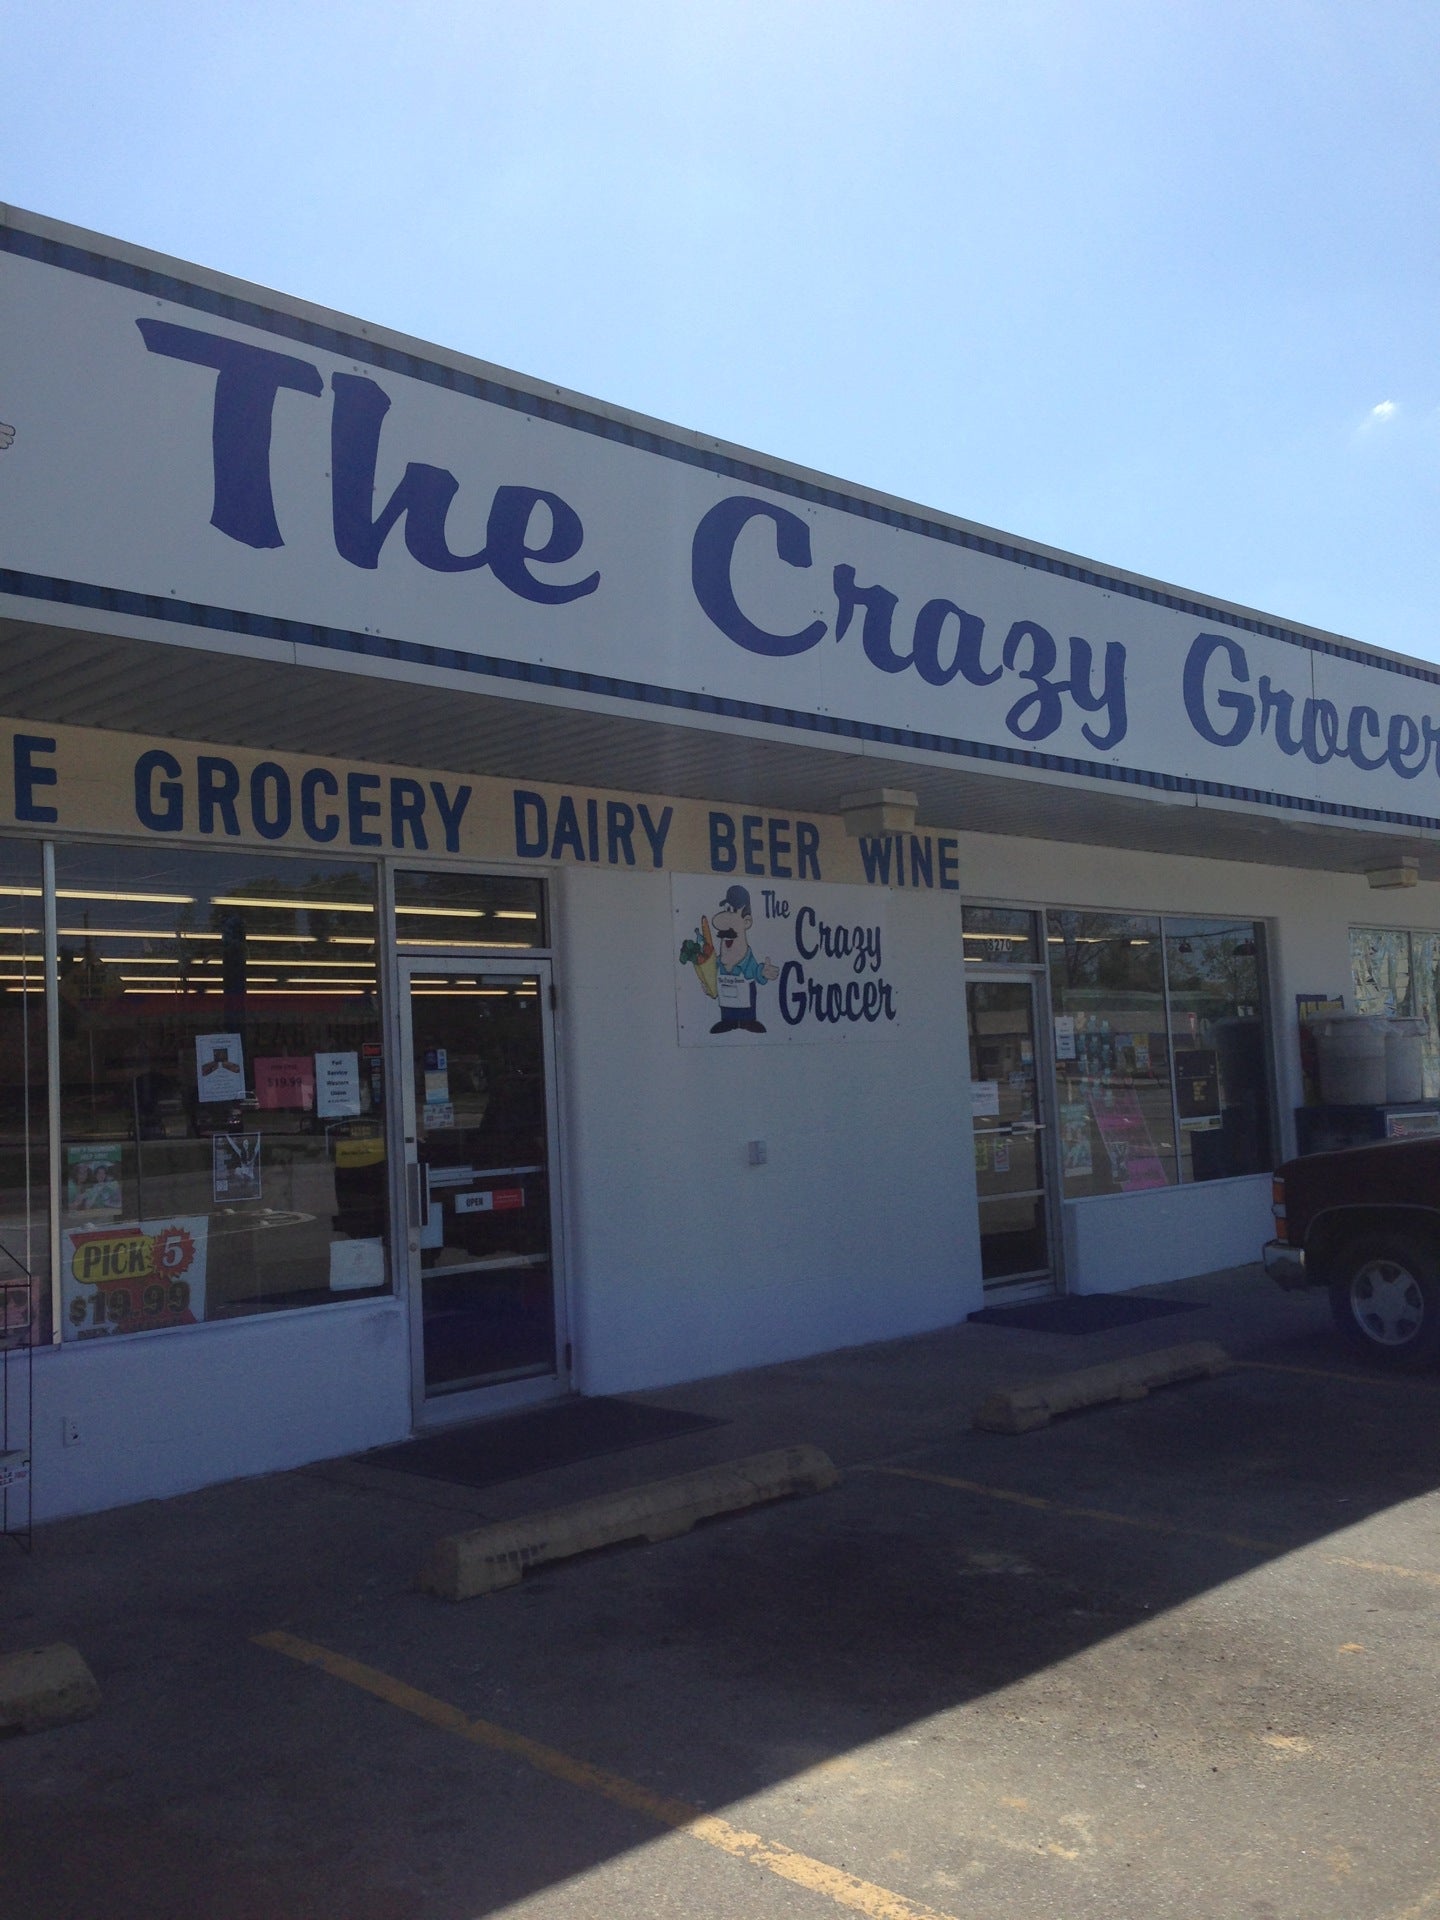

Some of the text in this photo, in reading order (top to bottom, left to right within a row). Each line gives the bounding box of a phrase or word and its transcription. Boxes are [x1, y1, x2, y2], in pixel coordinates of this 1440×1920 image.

[135, 317, 600, 604] The
[691, 495, 1127, 751] Crazy
[134, 749, 472, 853] GROCERY
[514, 789, 674, 868] DAIRY
[708, 811, 822, 881] BEER
[858, 828, 960, 891] WINE
[761, 889, 791, 919] The
[795, 905, 882, 974] Crazy
[778, 960, 897, 1026] Grocer
[465, 1197, 484, 1208] OPEN
[83, 1235, 184, 1278] PICK 5
[69, 1280, 191, 1327] $19.99
